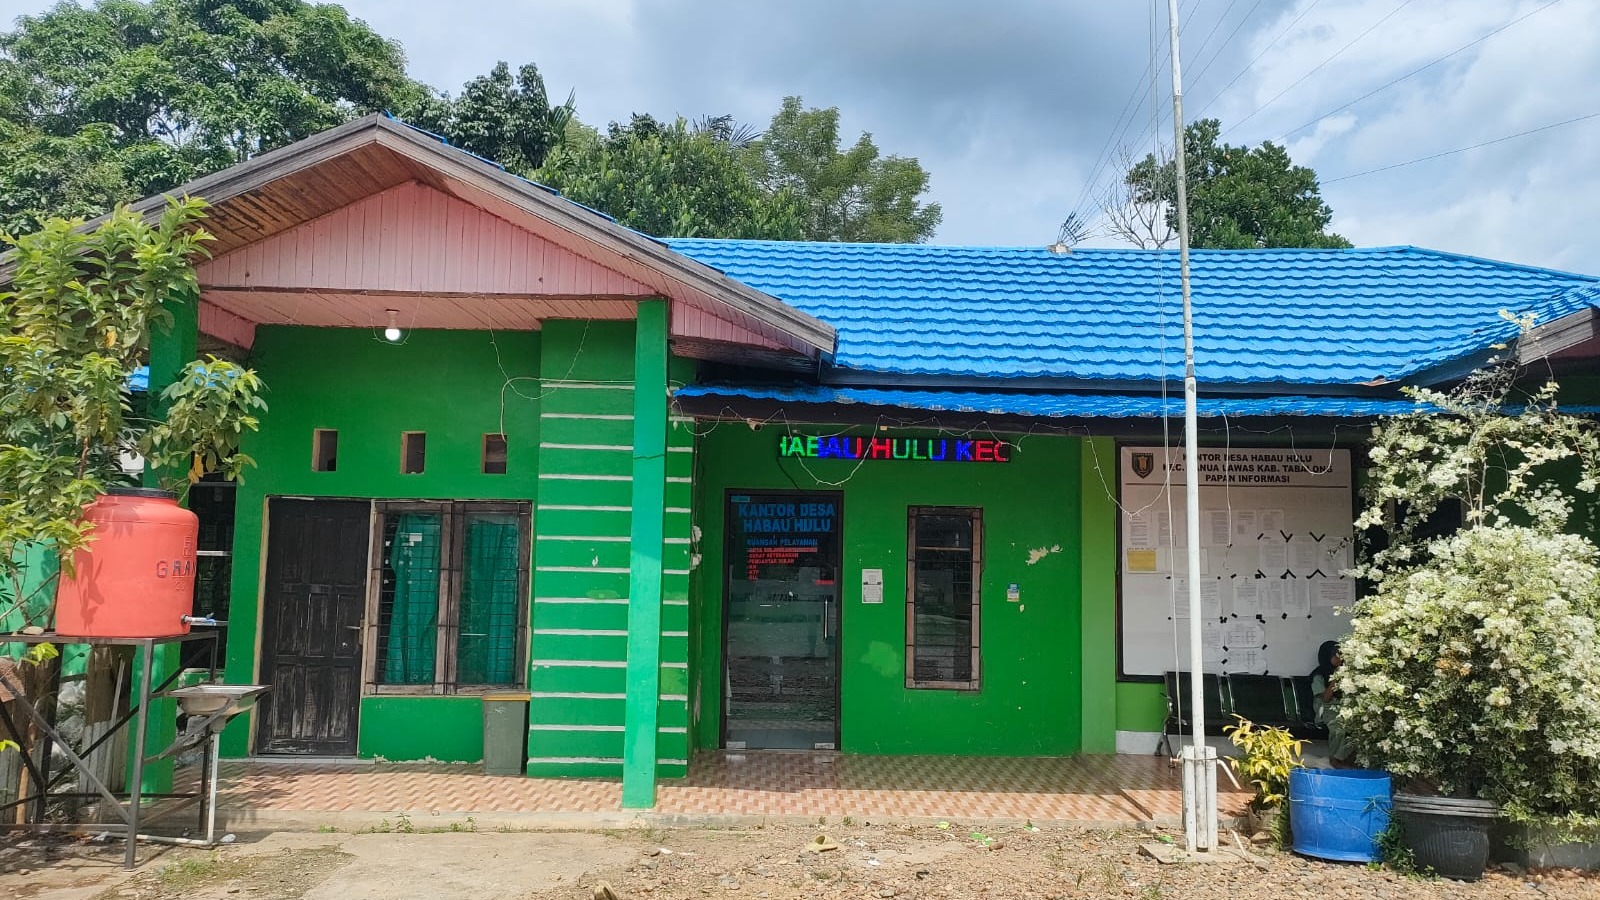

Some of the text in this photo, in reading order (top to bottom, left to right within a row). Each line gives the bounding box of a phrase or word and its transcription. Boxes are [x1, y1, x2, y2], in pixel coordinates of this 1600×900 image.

[872, 438, 946, 461] HULU
[956, 440, 1009, 462] KEC
[1224, 453, 1248, 462] DESA
[1251, 454, 1284, 462] HABAU
[1286, 454, 1313, 463] HULU
[1223, 464, 1255, 472] LAWAS
[1257, 464, 1280, 473] KAB.
[1205, 474, 1291, 483] PAPAN INFORMASI
[740, 504, 834, 517] KANTOR DESA
[744, 519, 831, 532] HABAU HULU
